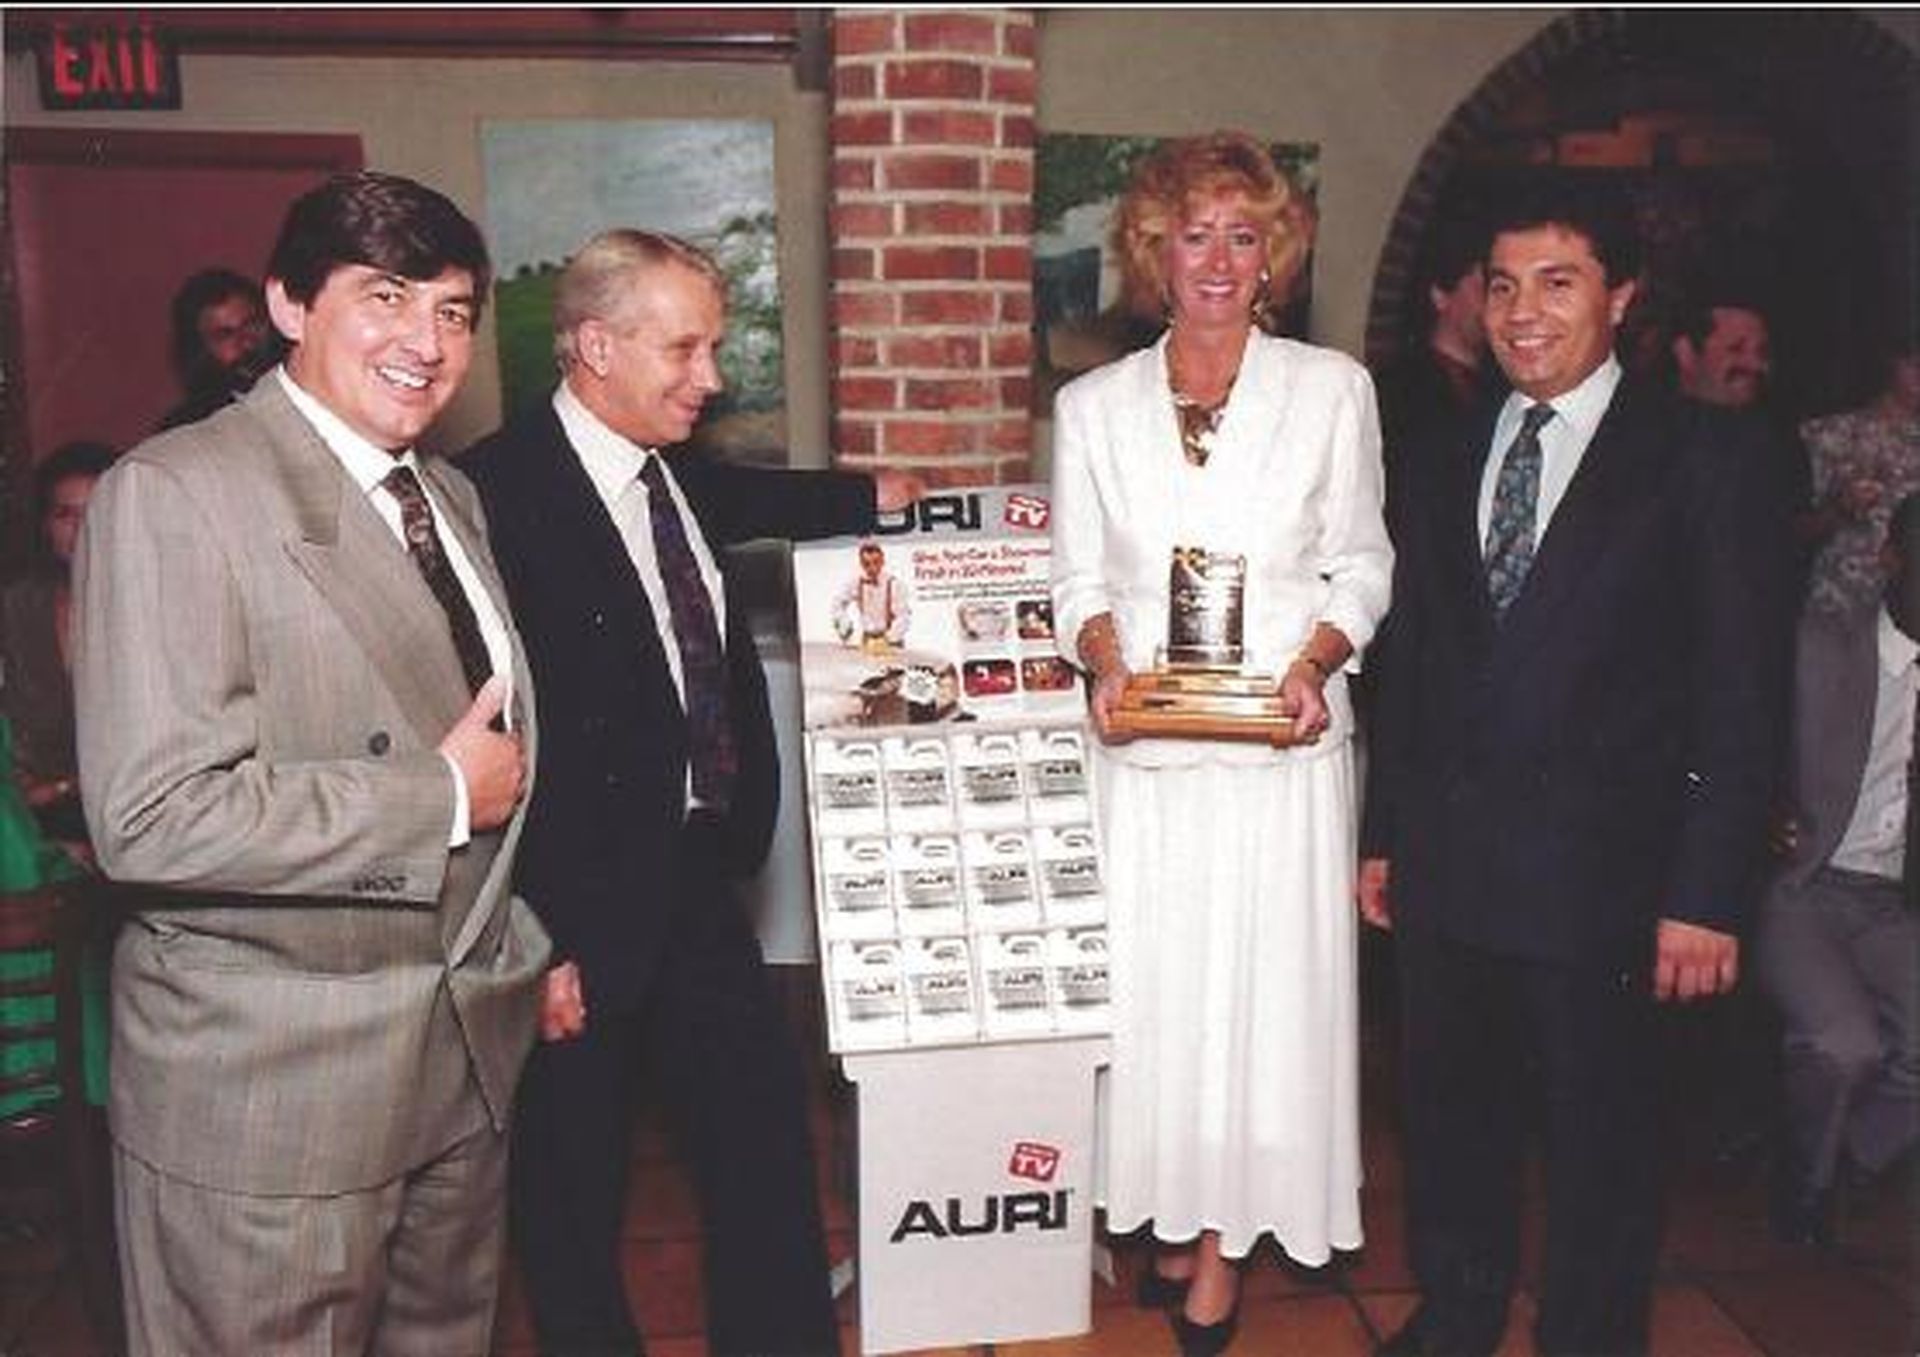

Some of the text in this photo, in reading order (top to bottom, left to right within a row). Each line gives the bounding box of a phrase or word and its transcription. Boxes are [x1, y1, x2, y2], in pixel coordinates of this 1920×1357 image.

[873, 493, 982, 535] URI
[1008, 503, 1047, 526] TV
[1016, 1154, 1055, 1176] TV
[889, 1188, 1068, 1244] AURI
